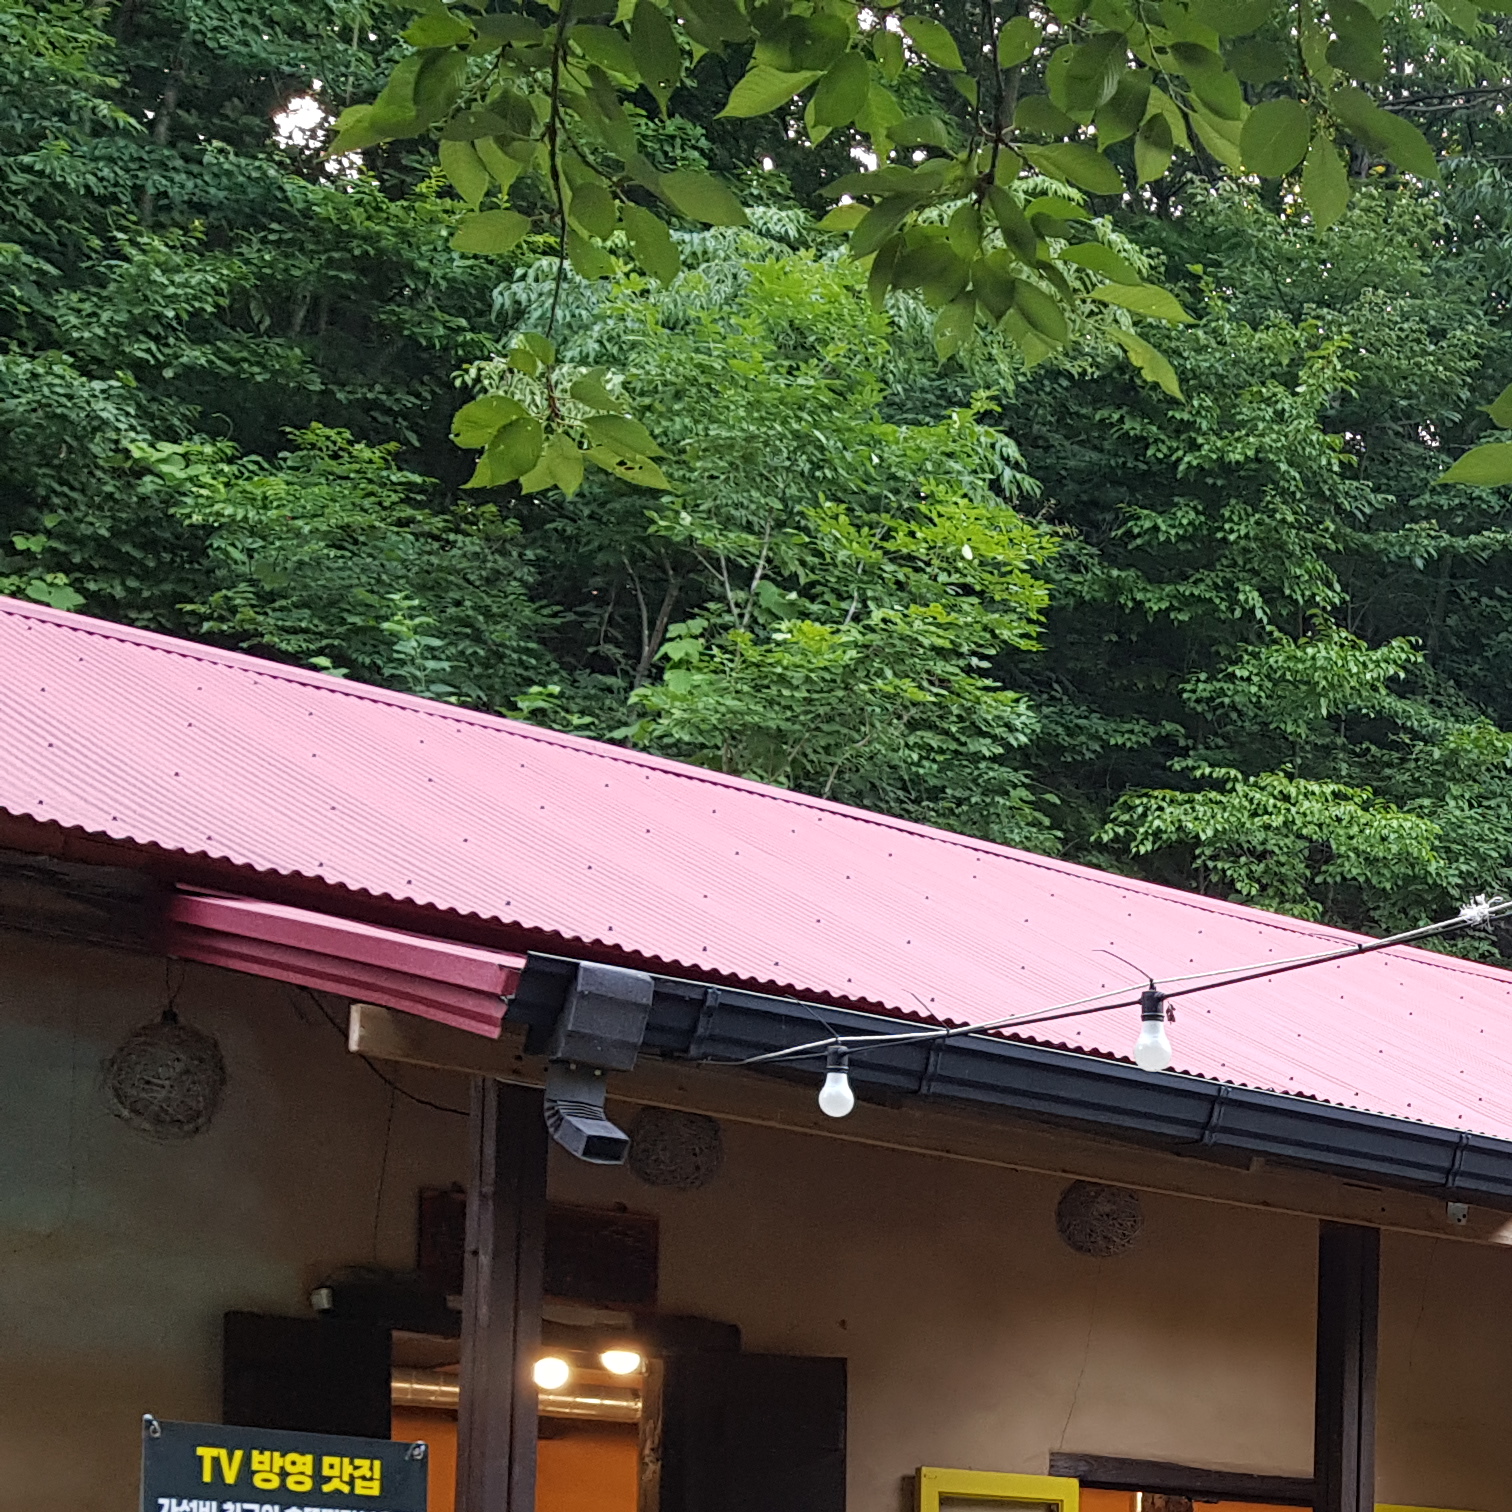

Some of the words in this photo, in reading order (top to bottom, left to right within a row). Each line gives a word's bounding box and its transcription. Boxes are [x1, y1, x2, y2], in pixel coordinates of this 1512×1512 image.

[196, 1446, 244, 1484] TV
[251, 1450, 313, 1492] 방영
[321, 1455, 382, 1496] 맛집
